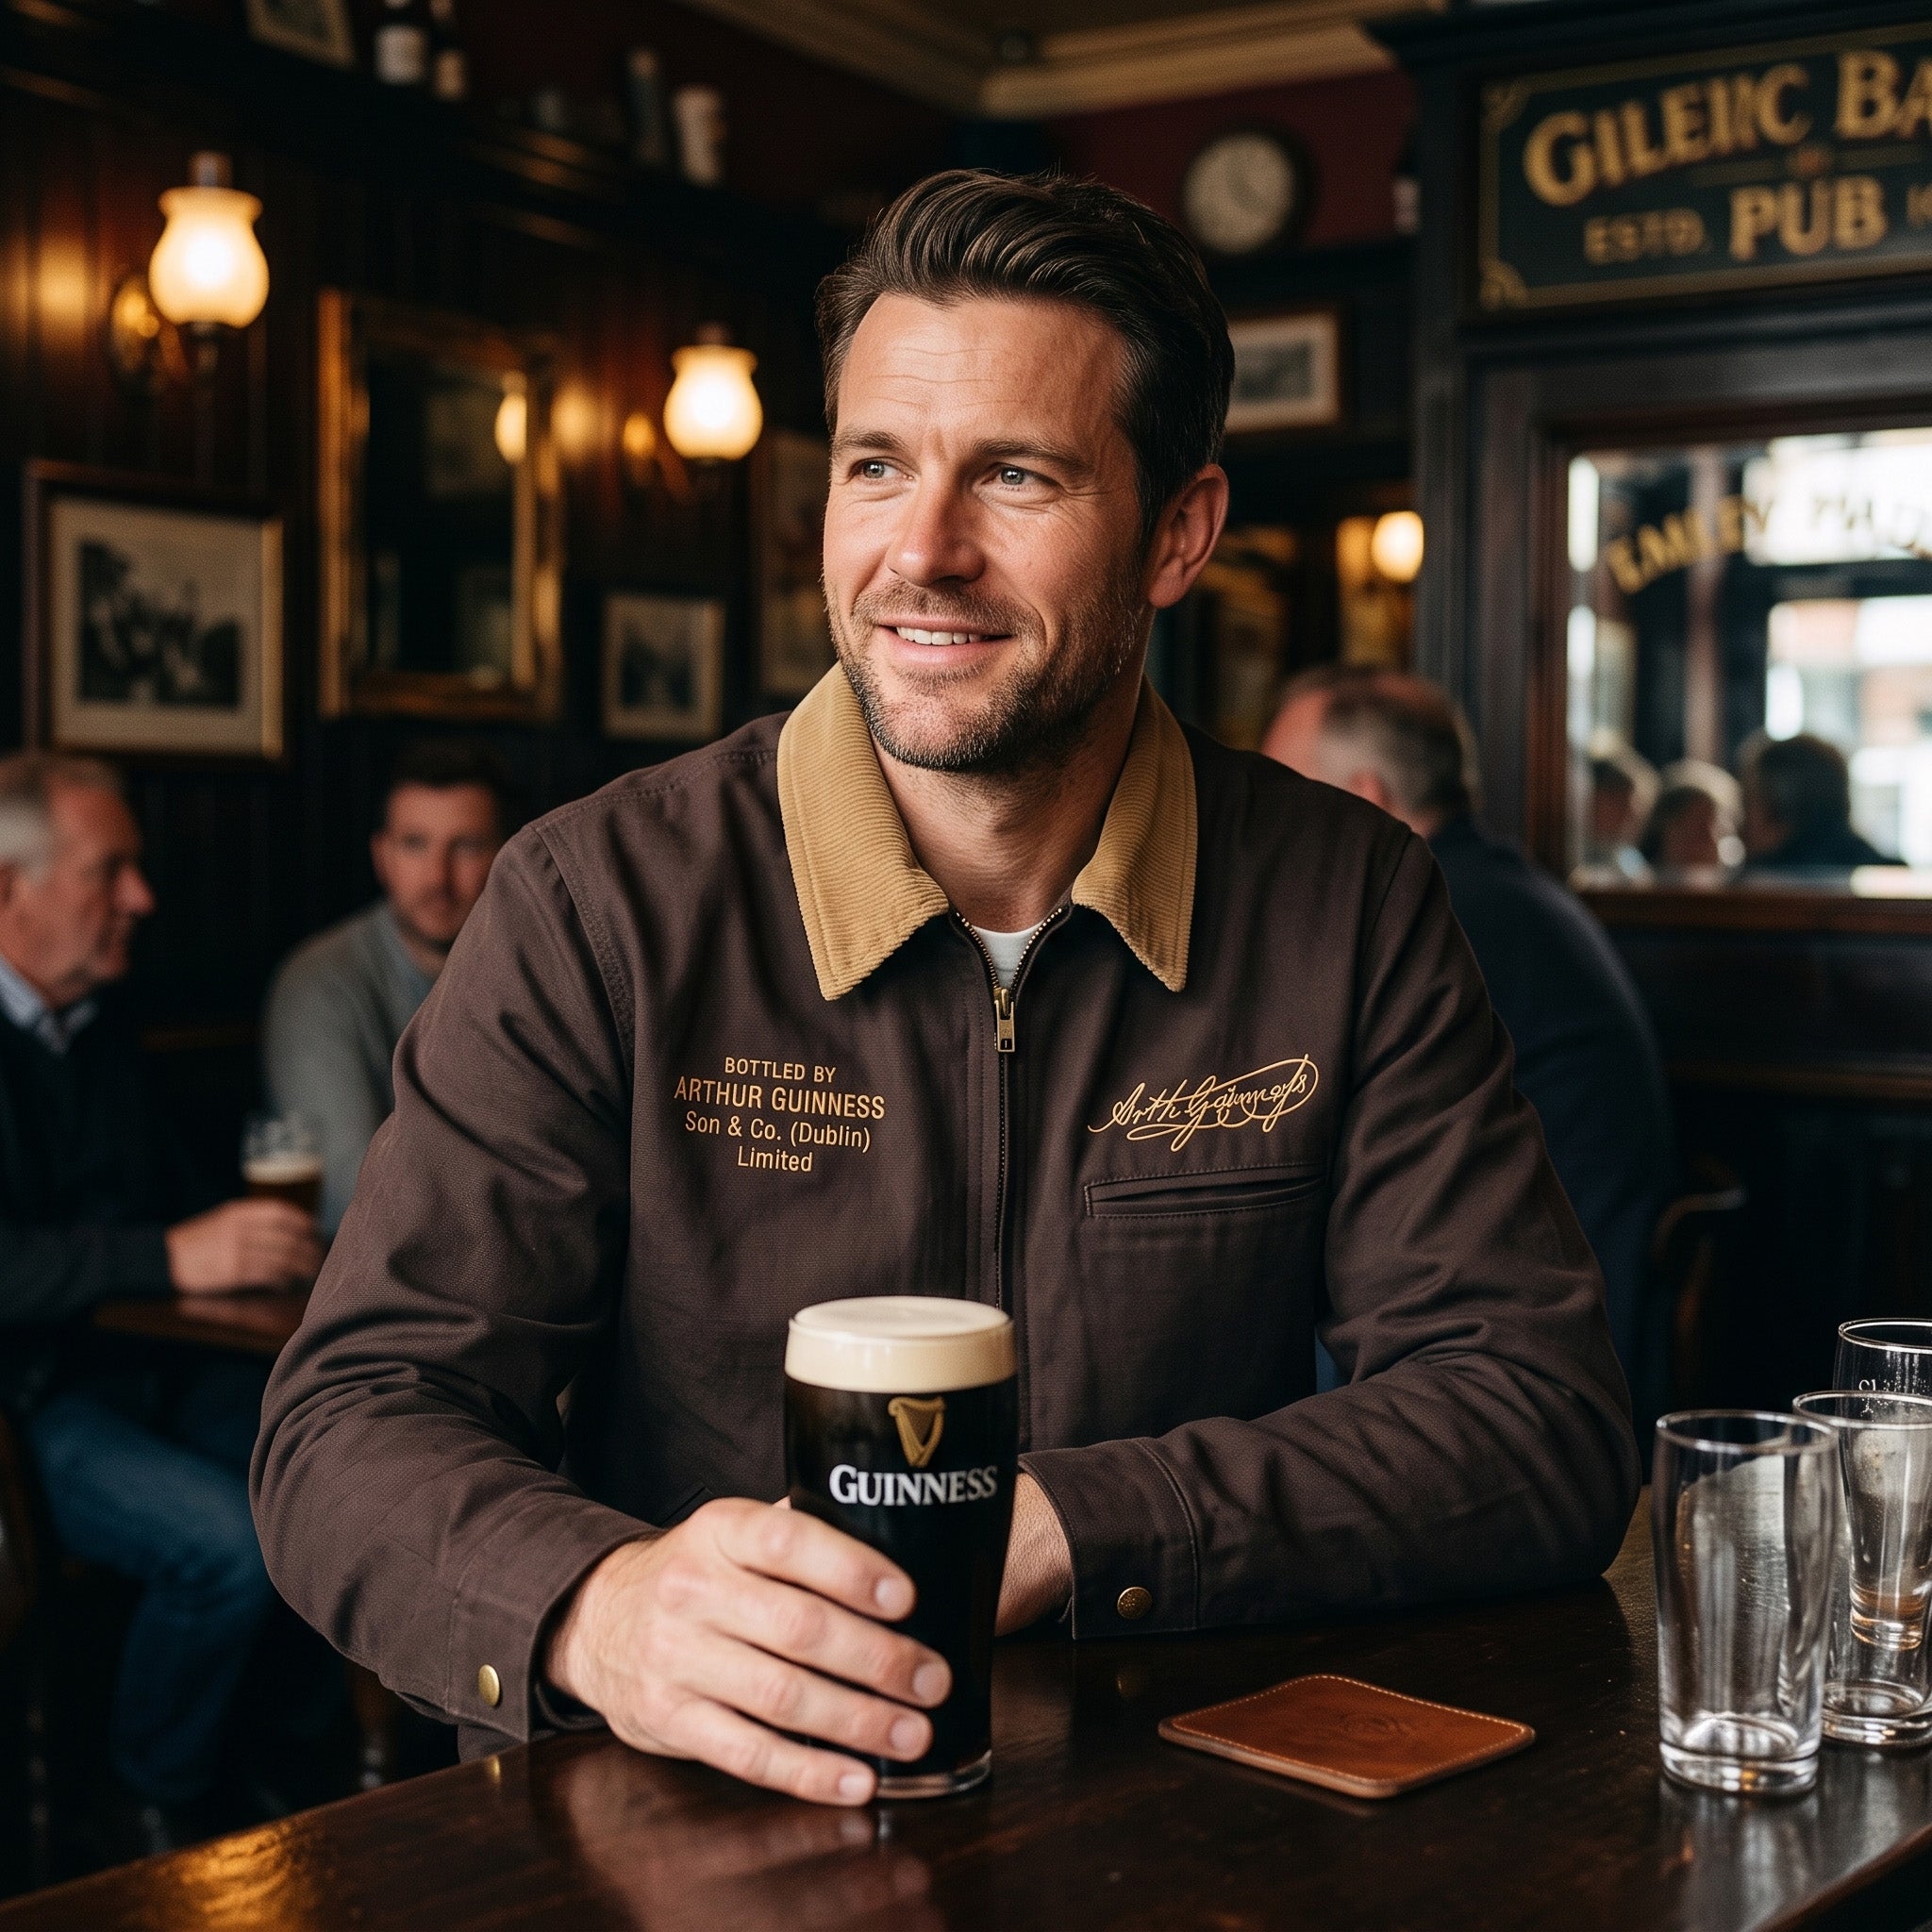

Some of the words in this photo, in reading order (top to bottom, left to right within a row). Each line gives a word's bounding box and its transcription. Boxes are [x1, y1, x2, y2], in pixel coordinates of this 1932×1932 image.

[1729, 175, 1888, 262] PUB
[724, 1057, 806, 1081] BOTTLED
[813, 1065, 837, 1083] BY
[674, 1075, 763, 1109] ARTHUR
[771, 1086, 886, 1120] GUINNESS
[685, 1110, 720, 1135] Son
[727, 1115, 742, 1138] &
[750, 1118, 782, 1141] Co.
[790, 1121, 871, 1154] (Dublin)
[737, 1145, 813, 1173] Limited
[829, 1464, 998, 1507] GUINNESS
